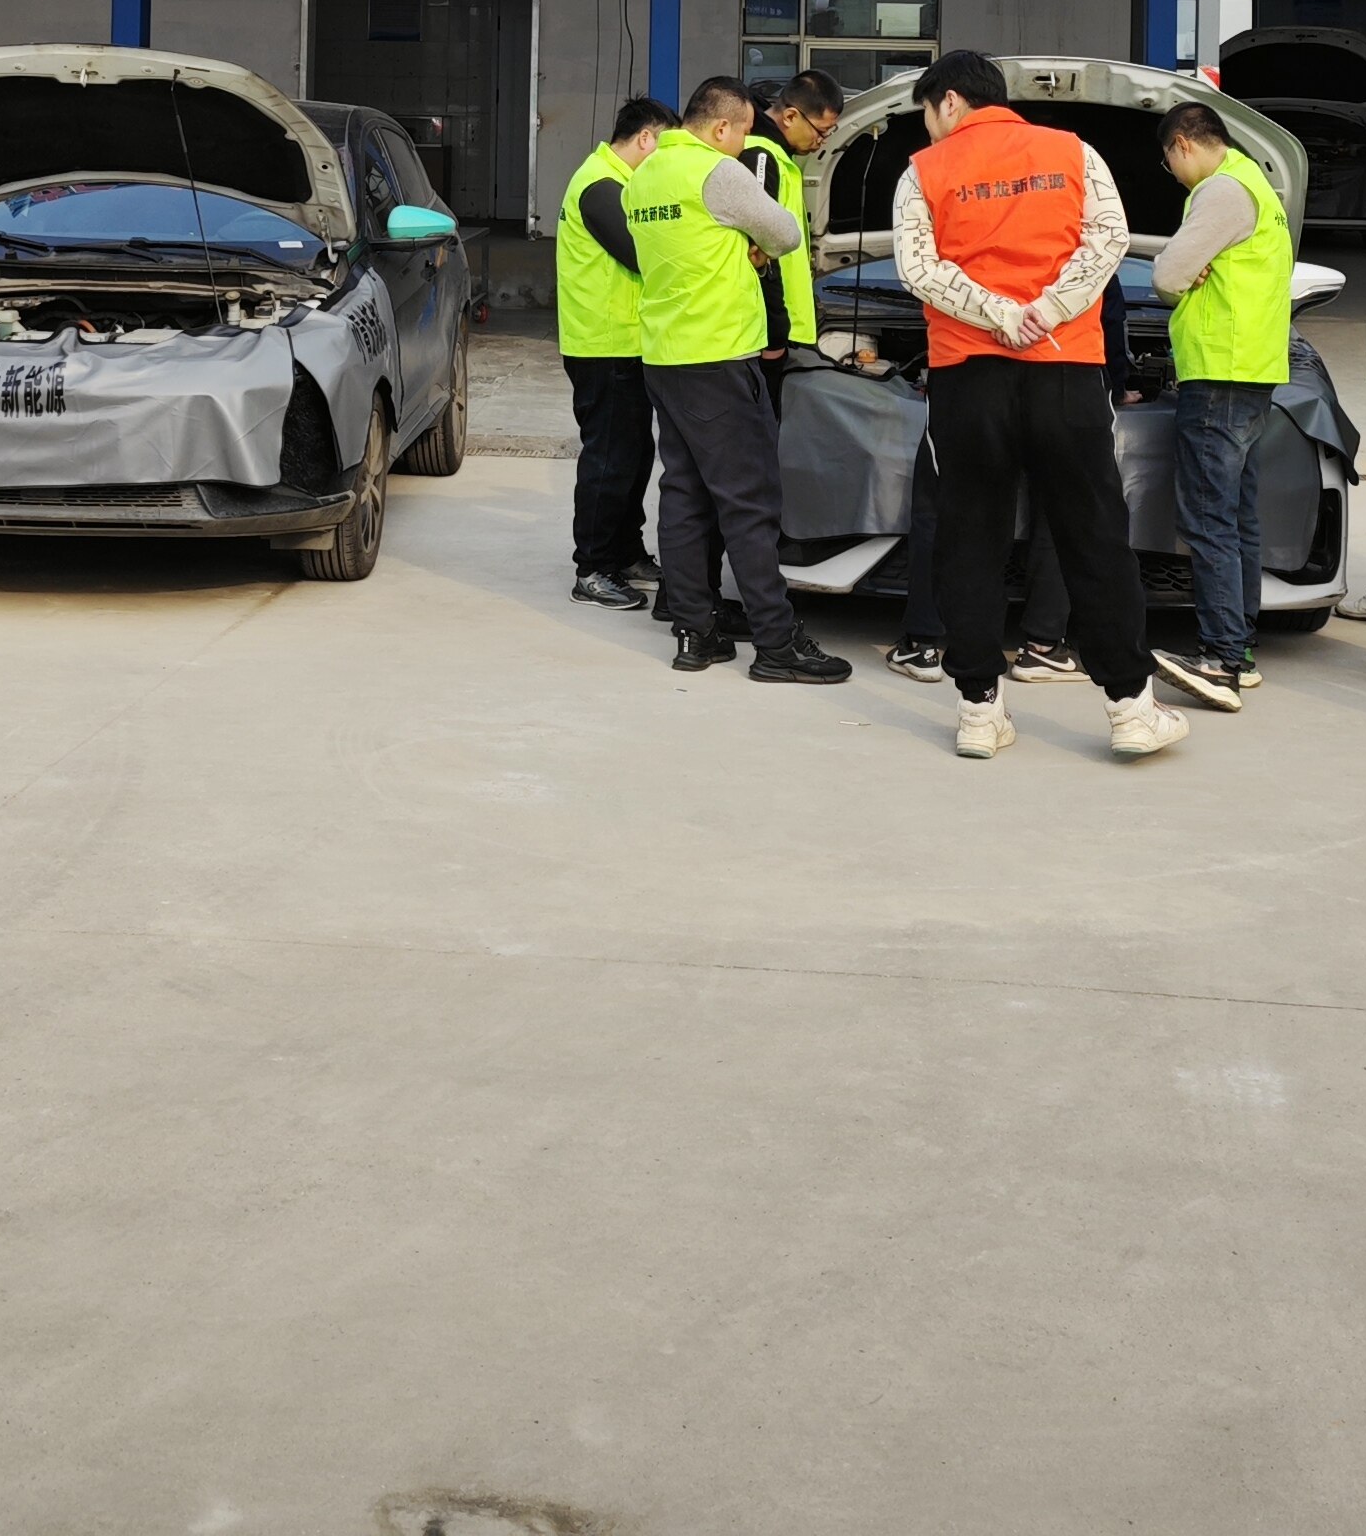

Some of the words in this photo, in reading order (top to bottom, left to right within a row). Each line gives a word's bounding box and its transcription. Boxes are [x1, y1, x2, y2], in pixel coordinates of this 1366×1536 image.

[955, 173, 1066, 202] 小青龙新能源
